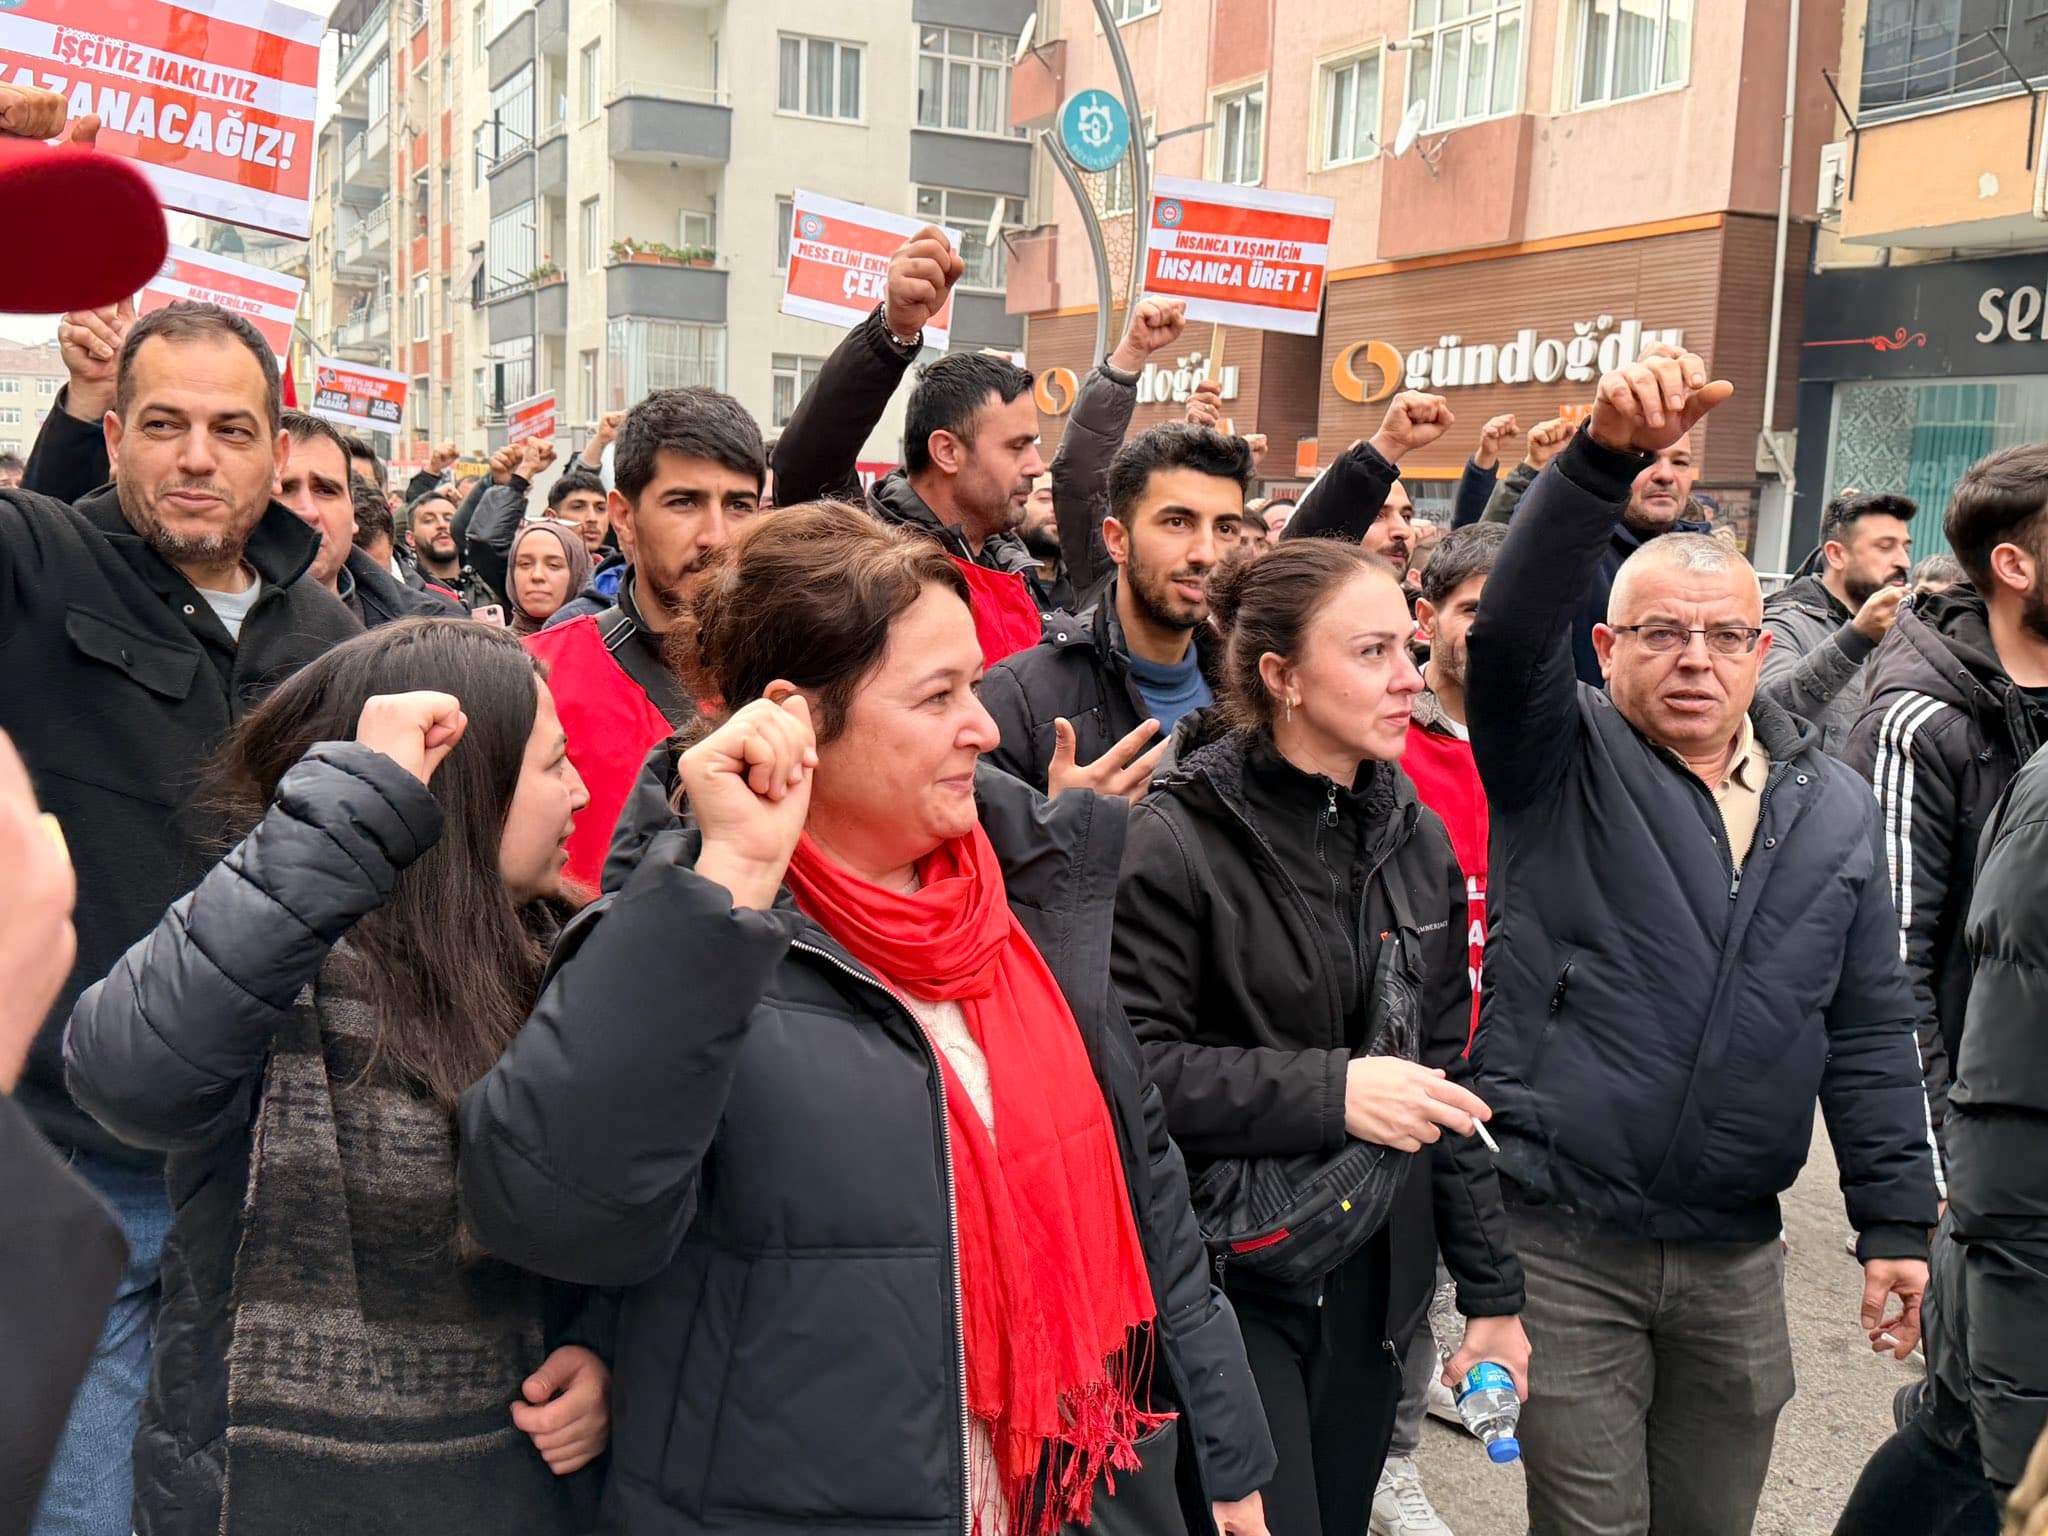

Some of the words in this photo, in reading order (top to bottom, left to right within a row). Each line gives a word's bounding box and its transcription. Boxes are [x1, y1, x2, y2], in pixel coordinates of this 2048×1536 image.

[52, 26, 143, 74] İŞÇİYİZ
[147, 55, 259, 103] HAKLIYIZ
[798, 243, 830, 260] MESS
[832, 249, 863, 268] ELİNİ
[864, 257, 889, 273] EKM
[1175, 231, 1229, 254] İNSANCA
[1233, 240, 1275, 259] YAŞAM
[1277, 242, 1302, 262] İÇİN
[1156, 251, 1244, 287] İNSANCA
[1248, 261, 1300, 292] ÜRET
[1302, 271, 1313, 293] !
